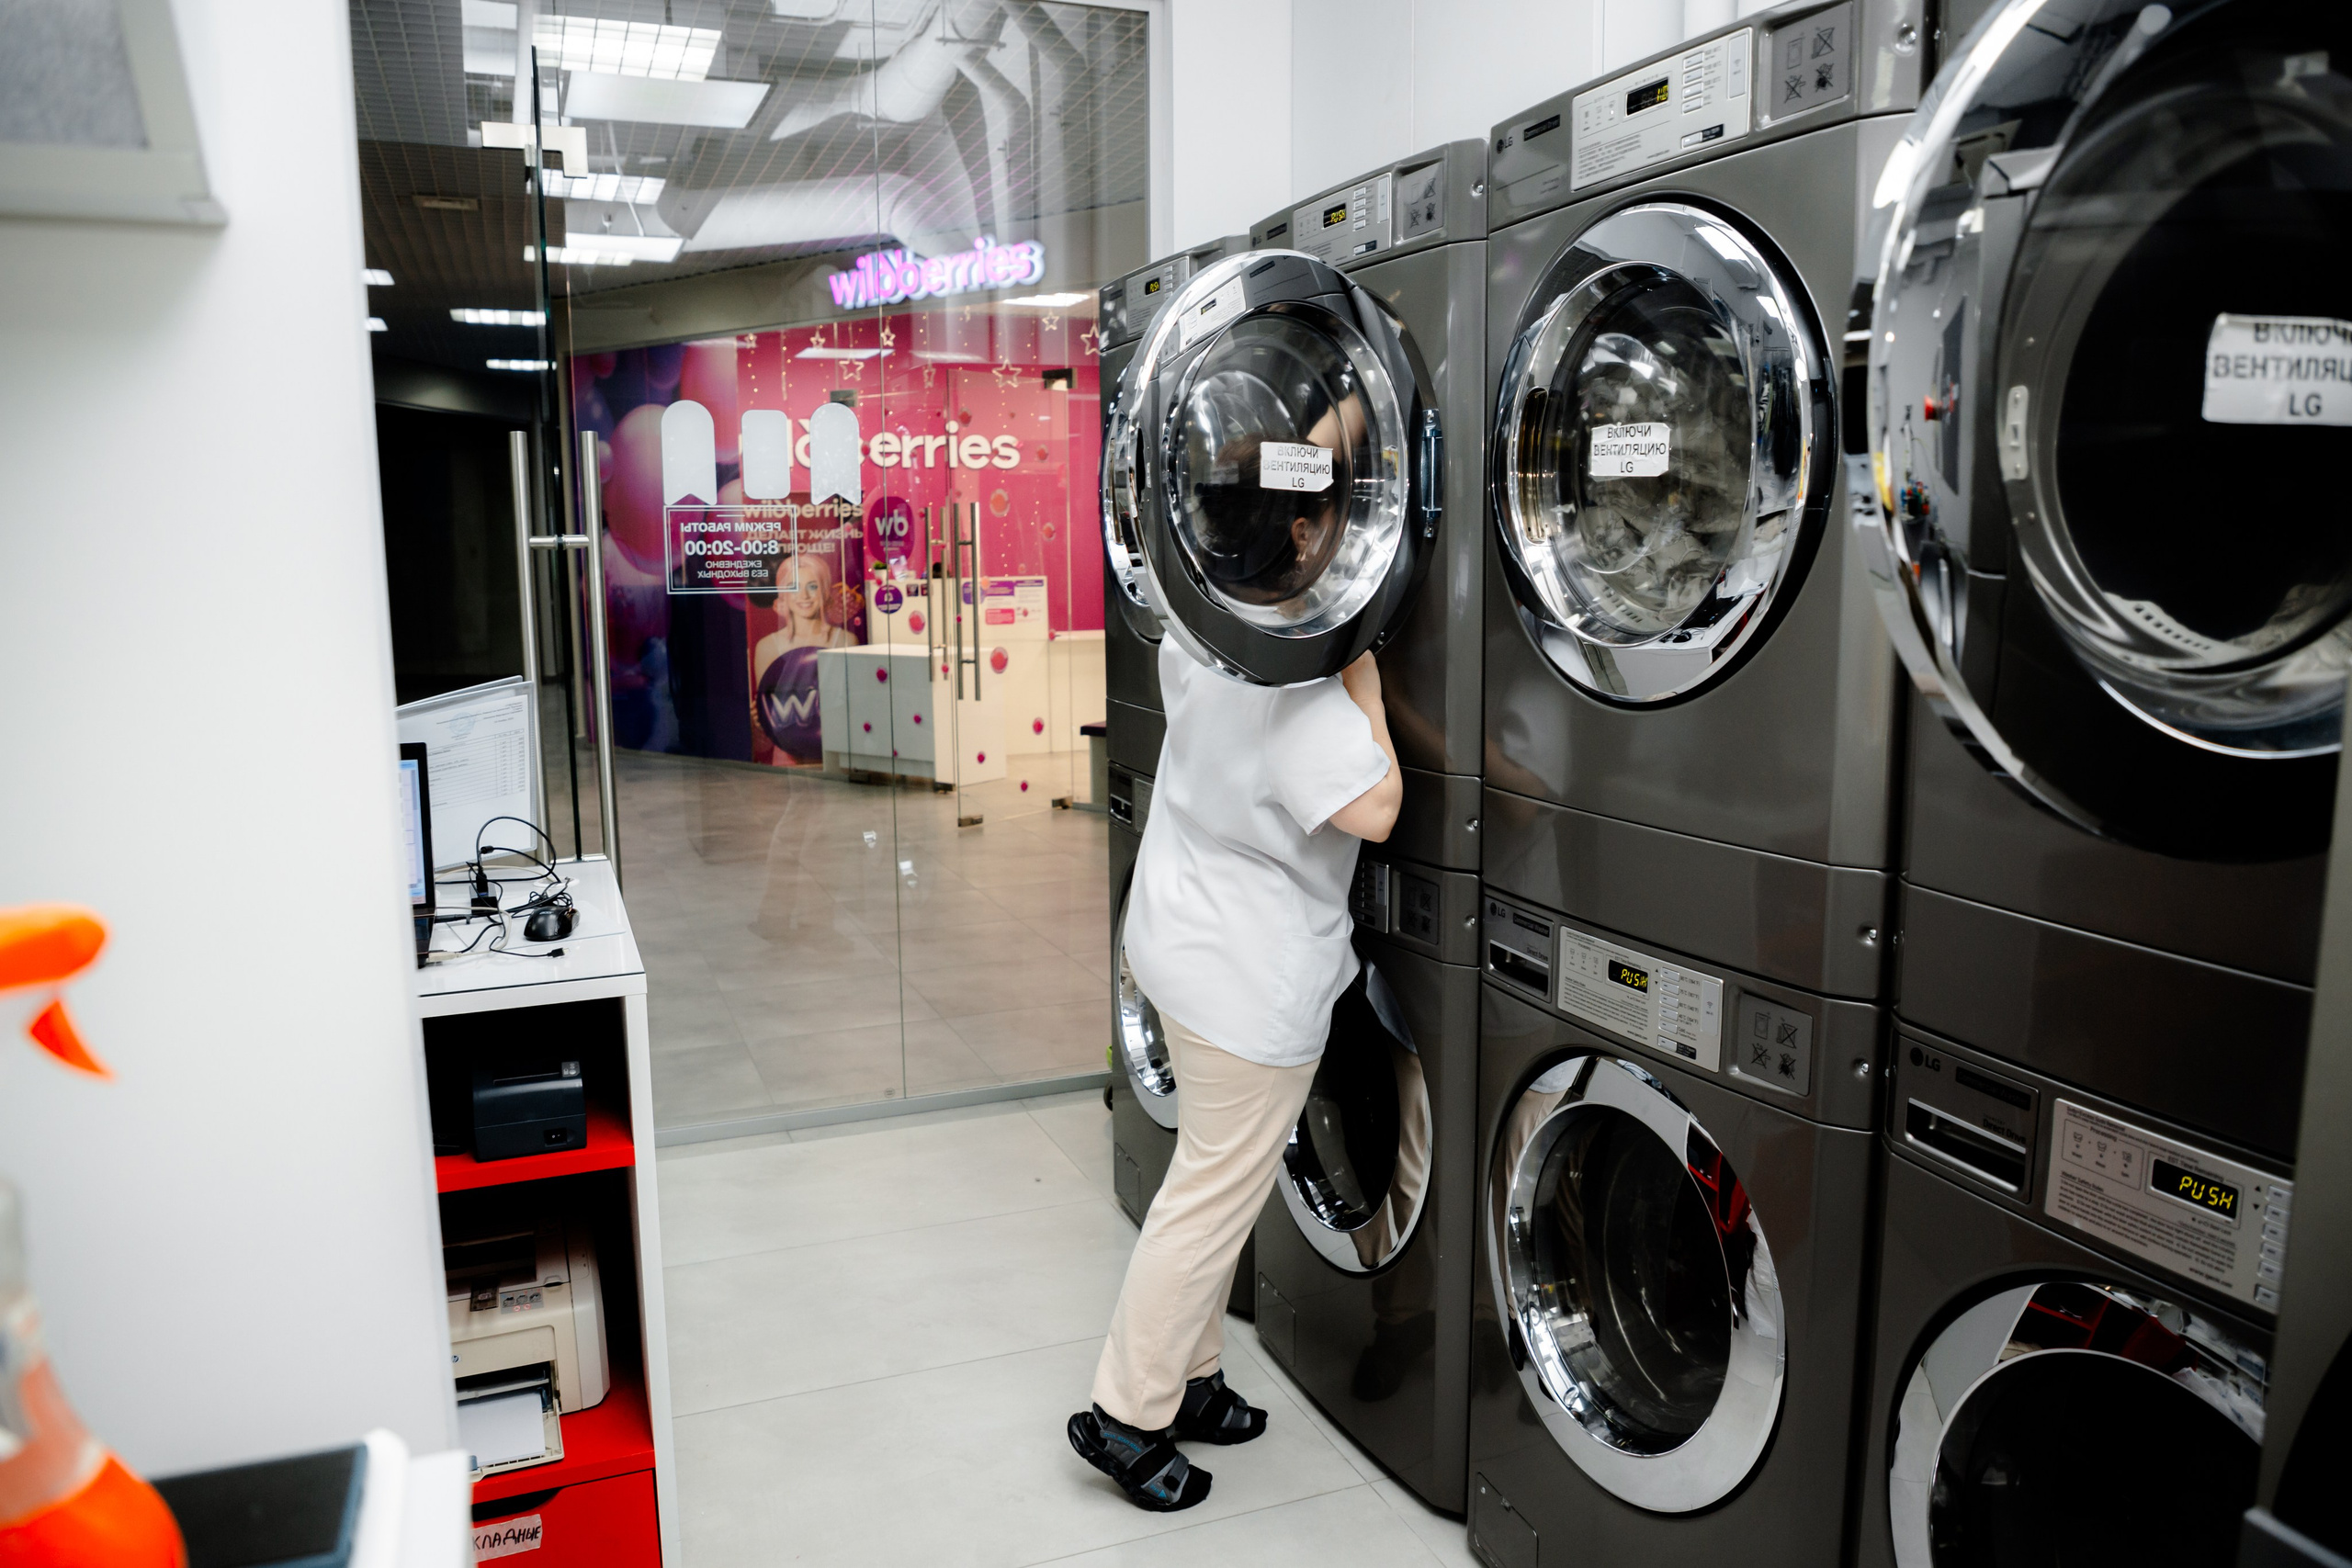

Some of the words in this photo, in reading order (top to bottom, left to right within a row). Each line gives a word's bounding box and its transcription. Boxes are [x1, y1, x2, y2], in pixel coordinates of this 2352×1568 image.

[2254, 322, 2352, 345] ВКЛЮЧ
[2213, 354, 2352, 386] ВЕНТИЛЯЦ
[2289, 392, 2323, 416] LG
[1607, 424, 1652, 439] ВКЛЮЧИ
[1277, 446, 1319, 459] ВКЛЮЧИ
[1594, 443, 1667, 457] ВЕНТИЛЯЦИЮ
[1262, 459, 1330, 476] ВЕНТИЛЯЦИЮ
[1620, 461, 1634, 473] LG
[1292, 477, 1305, 488] LG
[746, 529, 806, 541] ДЕЛАЕТ
[1498, 906, 1506, 919] LG
[1925, 1055, 1940, 1072] LG
[1983, 1118, 2005, 1135] Direct
[2178, 1175, 2233, 1210] PUSH
[472, 1526, 541, 1551] КЛАДНЫЕ
